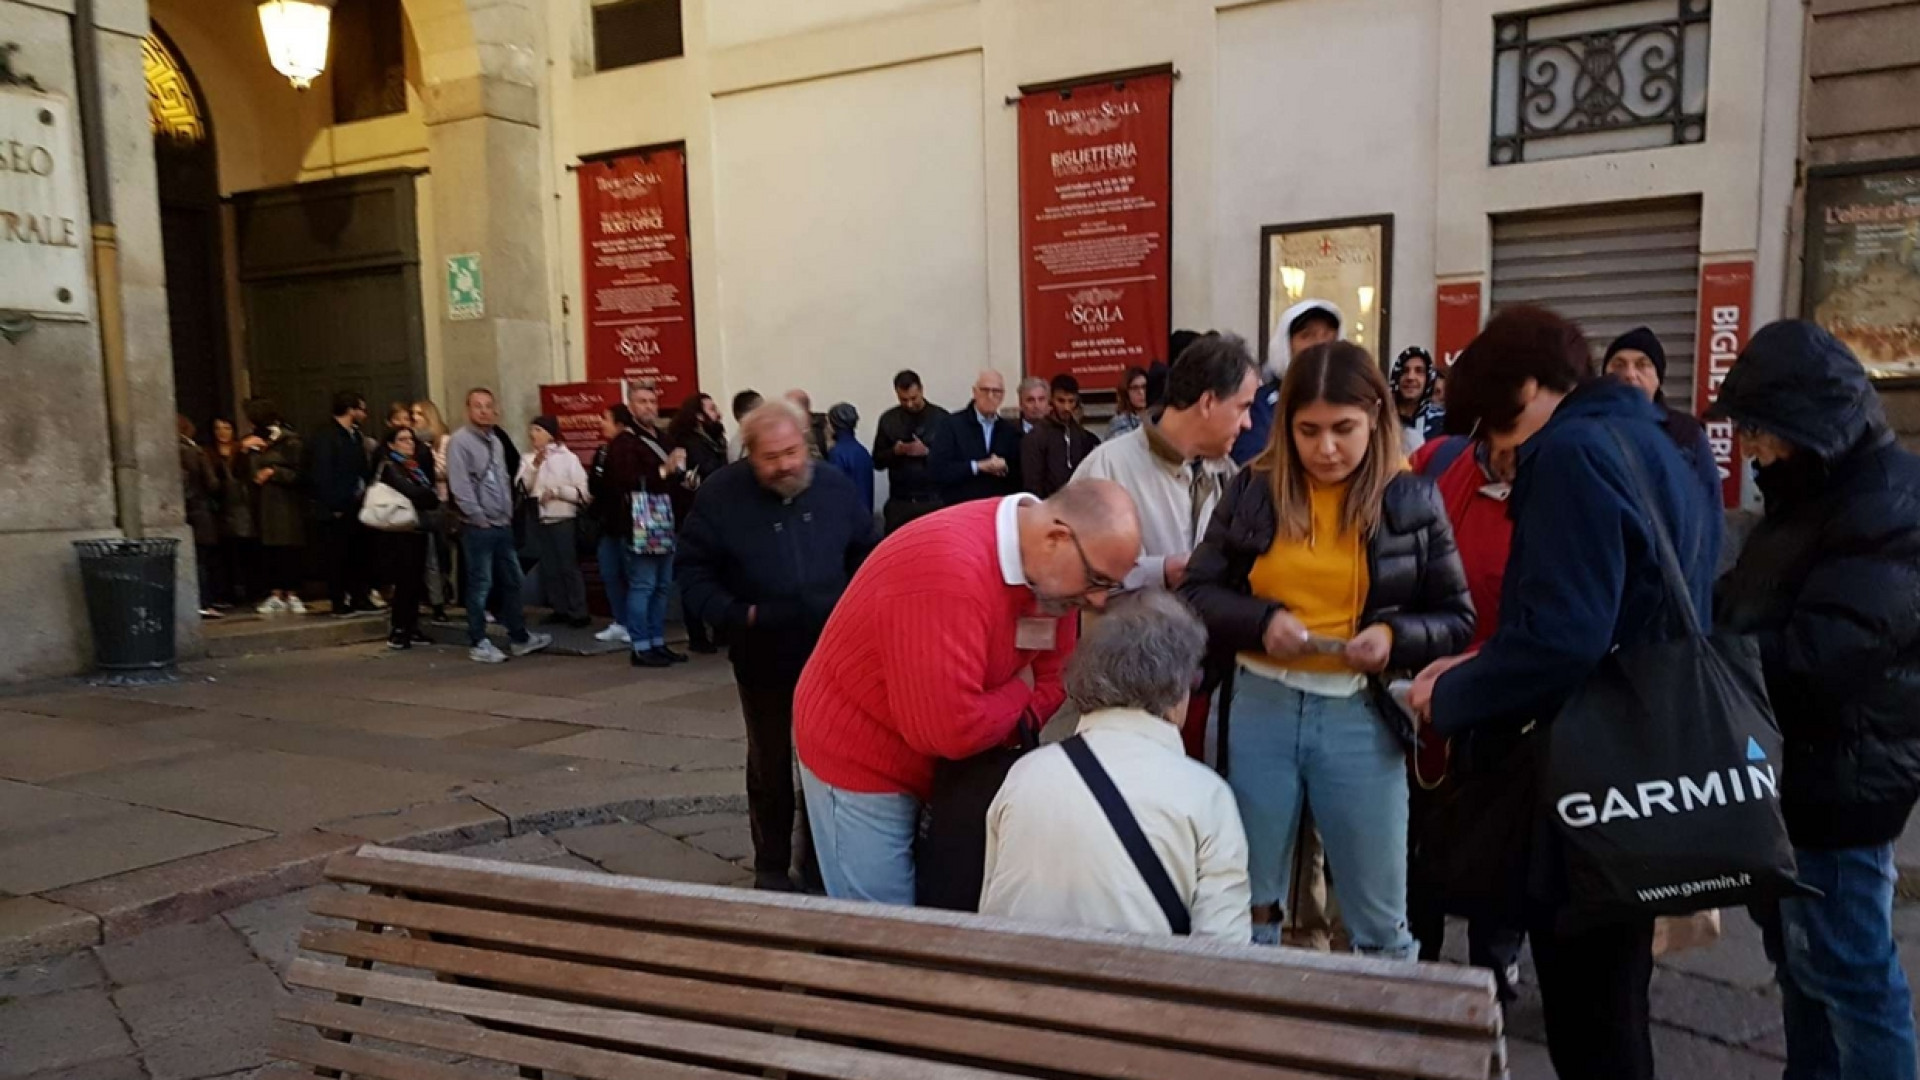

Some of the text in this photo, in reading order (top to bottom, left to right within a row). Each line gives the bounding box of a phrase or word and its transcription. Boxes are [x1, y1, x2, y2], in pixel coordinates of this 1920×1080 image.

[1100, 101, 1140, 118] SCALA
[1051, 141, 1138, 168] BIGLIETTERIA
[1072, 303, 1124, 325] SCALA
[620, 337, 661, 356] SCALA
[1708, 305, 1740, 480] BIGLIEERIA
[1556, 763, 1778, 829] GARMIN
[1637, 872, 1752, 902] www.garmin.it
